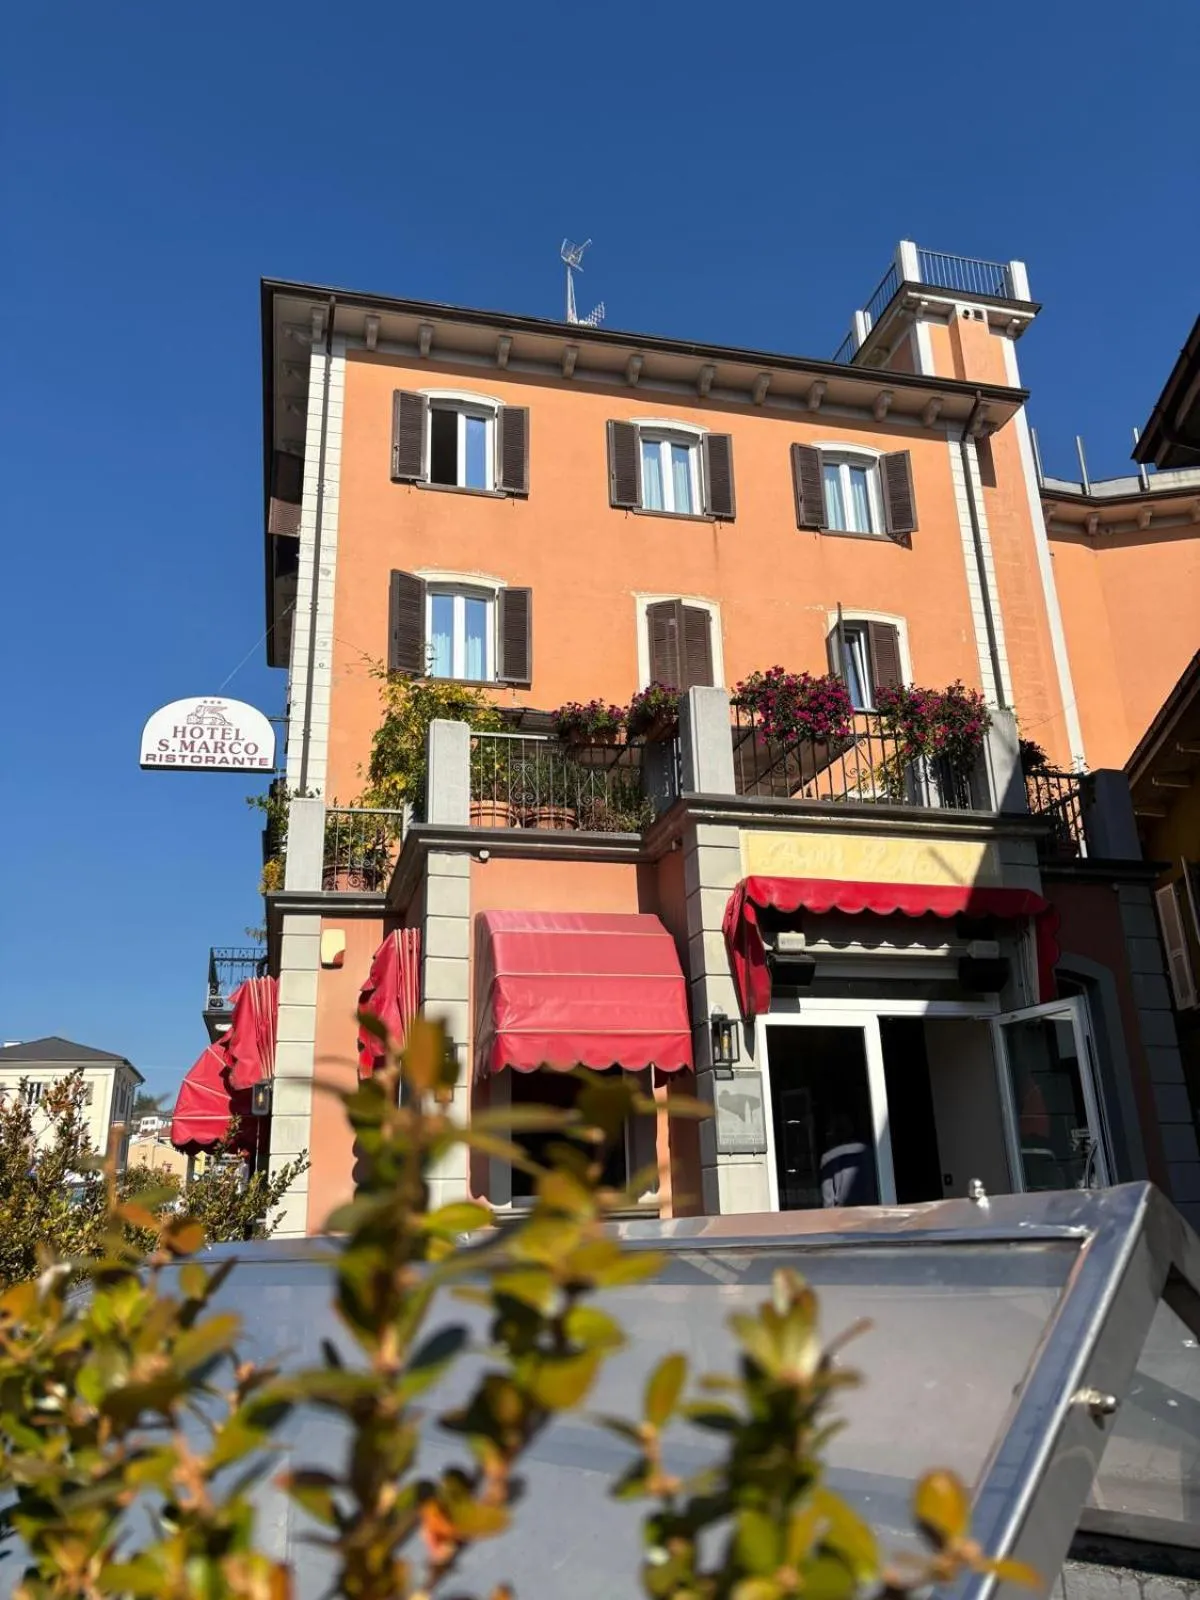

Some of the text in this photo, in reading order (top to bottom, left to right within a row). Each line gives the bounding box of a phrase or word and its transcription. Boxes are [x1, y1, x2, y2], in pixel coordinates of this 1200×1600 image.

[172, 726, 245, 741] HOTEL
[157, 739, 259, 755] S.MARCO
[145, 754, 269, 766] RISTORANTE
